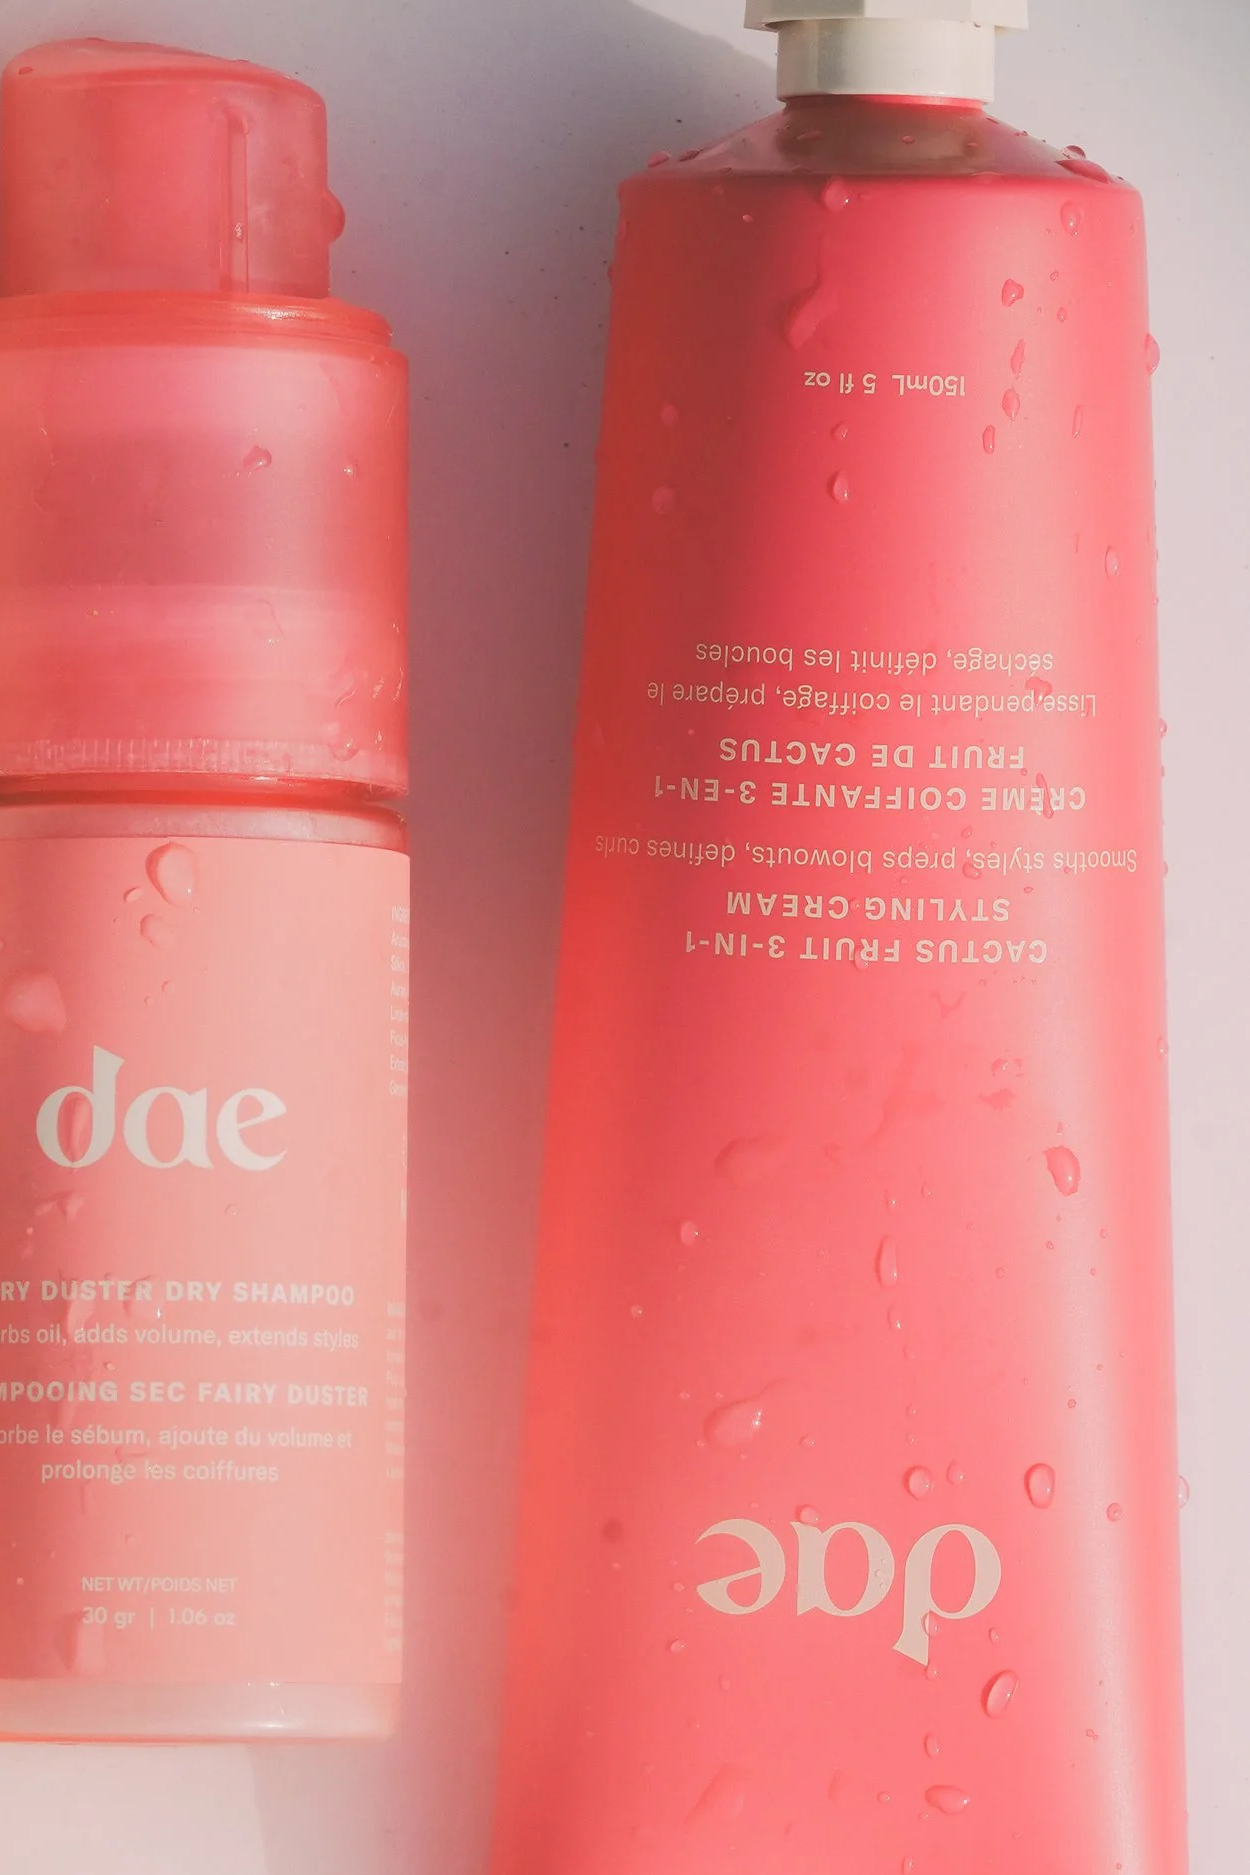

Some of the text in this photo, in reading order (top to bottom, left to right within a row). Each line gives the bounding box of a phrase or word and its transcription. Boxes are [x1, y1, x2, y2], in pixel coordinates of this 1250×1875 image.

[804, 371, 966, 397] 150mL 5 fl oz
[696, 644, 1054, 677] séchage, définit les boucles
[647, 681, 1035, 718] pendant le coiffage, prépare le
[719, 737, 1024, 769] FRUIT DE CACTUS
[654, 775, 967, 811] COIFFANTE 3-EN-1
[595, 834, 1137, 876] Smooths styles, preps blowouts, defines curls
[726, 891, 1010, 922] STYLING CREAM
[685, 930, 1048, 964] CACTUS FRUIT 3-IN-1
[35, 1045, 288, 1171] dae
[41, 1279, 154, 1302] DUSTER
[165, 1281, 222, 1302] DRY
[232, 1281, 355, 1307] SHAMPOO
[36, 1324, 67, 1346] oil,
[74, 1323, 128, 1344] adds
[135, 1324, 222, 1347] volume,
[229, 1325, 307, 1347] extends
[313, 1329, 359, 1351] styles
[130, 1381, 186, 1403] SEC
[199, 1382, 276, 1404] FAIRY
[287, 1384, 369, 1407] DUSTER
[46, 1425, 64, 1445] le
[71, 1424, 150, 1448] sébum,
[159, 1426, 229, 1449] ajoute
[235, 1427, 261, 1447] du
[267, 1428, 337, 1449] volume
[41, 1460, 279, 1485] prolonge les coiffures
[81, 1576, 238, 1593] NET WT/POIDS NET
[694, 1518, 1002, 1667] dae
[82, 1607, 235, 1629] 30 gr 1.06 oz
